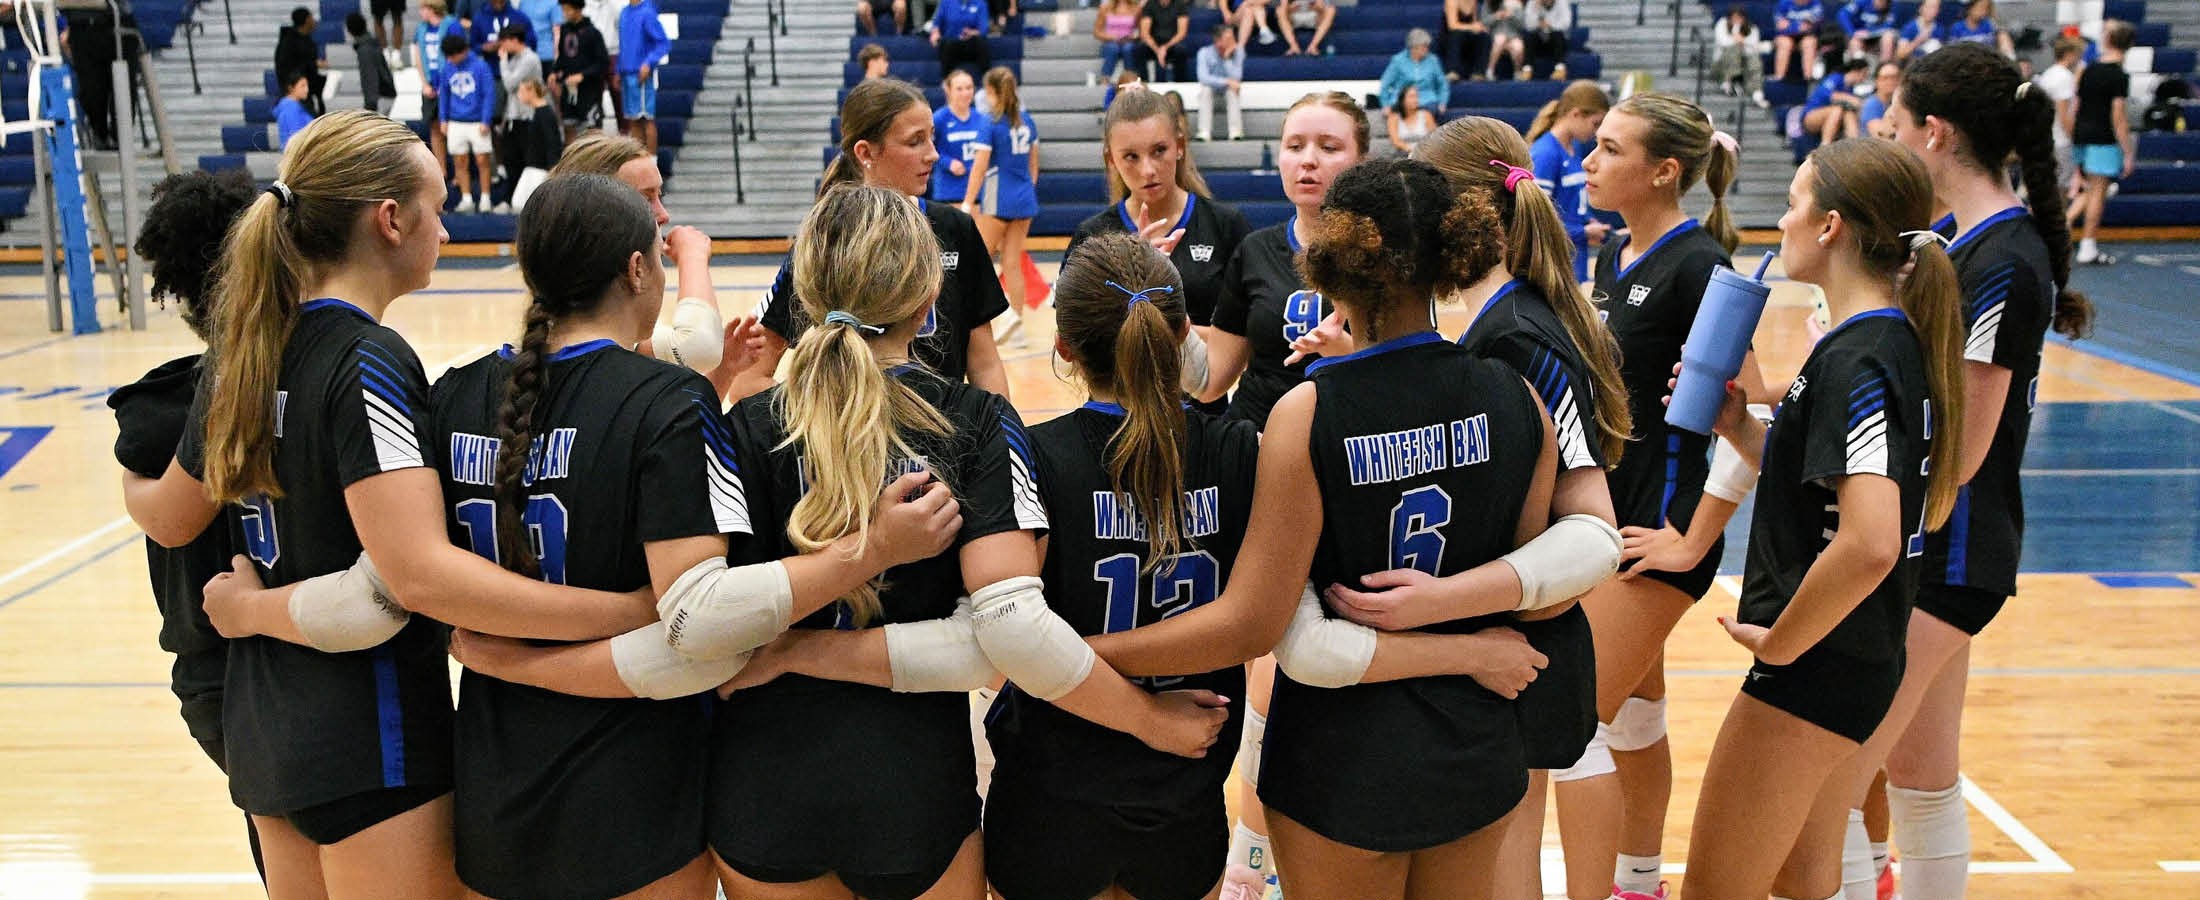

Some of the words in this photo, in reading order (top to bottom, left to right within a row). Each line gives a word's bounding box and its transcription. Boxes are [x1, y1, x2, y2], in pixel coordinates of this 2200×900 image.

[1010, 125, 1031, 155] 12
[1283, 289, 1323, 343] 9
[1343, 423, 1447, 486] WHITEFISH
[1450, 412, 1490, 468] BAY
[1388, 483, 1452, 578] 6
[1093, 549, 1220, 687] 12
